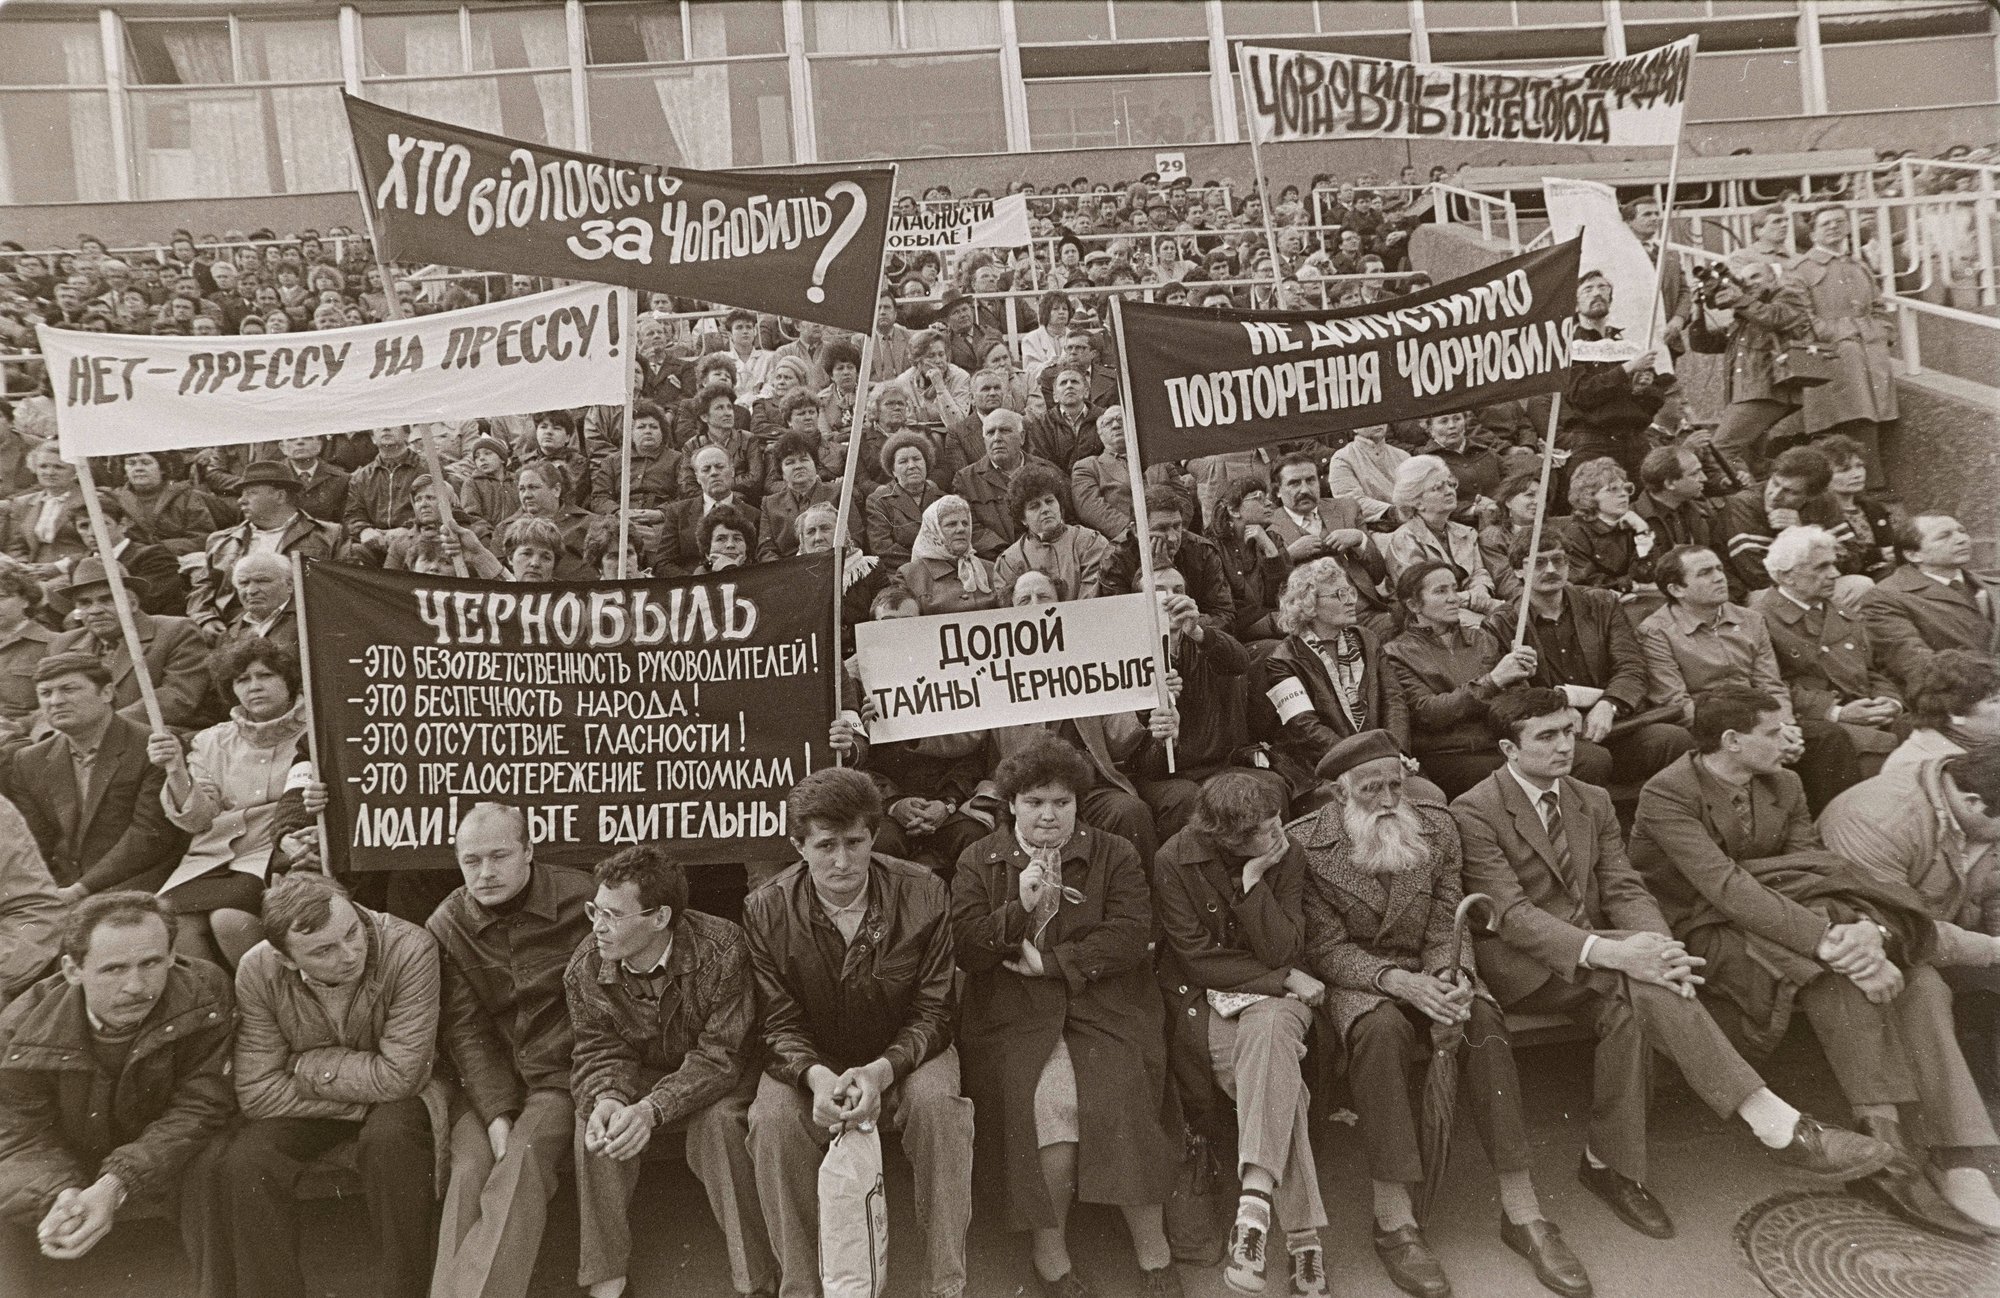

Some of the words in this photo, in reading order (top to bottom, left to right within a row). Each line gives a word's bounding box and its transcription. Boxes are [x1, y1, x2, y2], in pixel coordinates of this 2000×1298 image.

[377, 133, 471, 216] ХТО
[1160, 160, 1184, 173] 29
[1240, 319, 1304, 356] НЕ
[1310, 268, 1533, 351] ДОПУСТИМО
[368, 335, 424, 379] НА
[1164, 351, 1382, 429] ПОВТОРЕННЯ
[412, 582, 760, 648] ЧЕРНОБЫЛЬ
[939, 606, 1064, 670] ДОЛОЙ
[413, 646, 632, 685] БЕЗОТВЕТСТВЕННОСТЬ
[414, 683, 563, 718] БЕСПЕЧНОСТЬ
[414, 723, 568, 756] ОТСУТСТВИЕ
[418, 761, 647, 796] ПРЕДОСТЕРЕЖЕНИЕ
[599, 801, 787, 847] БДИТЕЛЬНЫ
